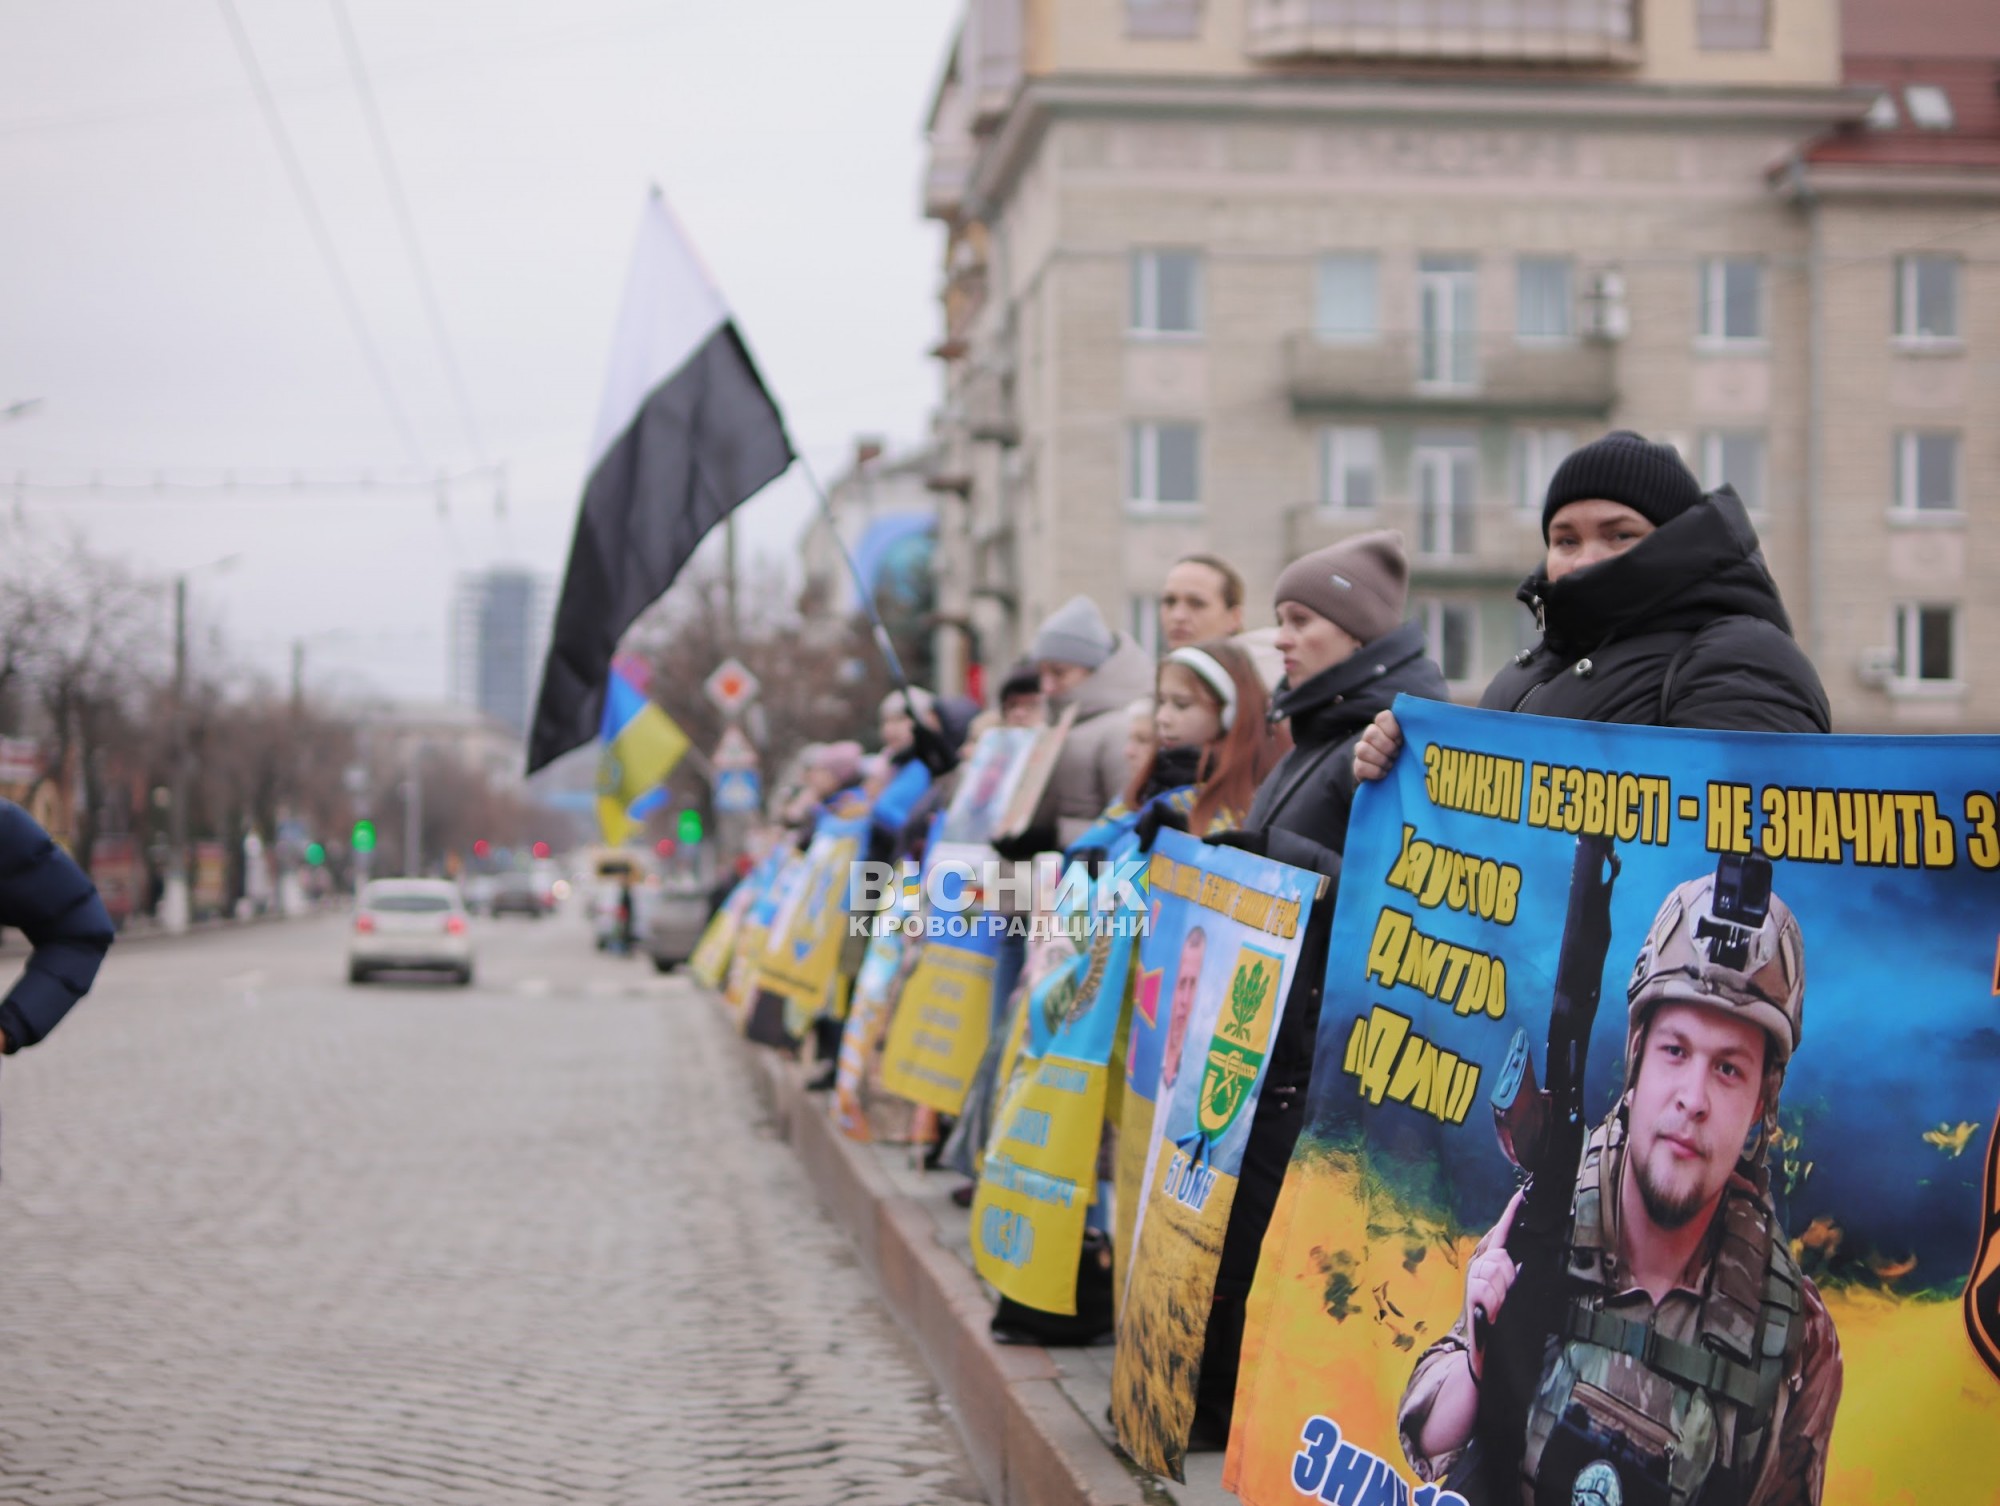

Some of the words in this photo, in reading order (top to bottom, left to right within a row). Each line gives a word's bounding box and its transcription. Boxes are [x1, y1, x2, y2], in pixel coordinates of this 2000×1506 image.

[1425, 743, 1524, 823] ЗНИКЛІ
[1528, 762, 1670, 846] БЕЗВІСТІ
[1706, 780, 1752, 854] НЕ
[1761, 784, 1956, 869] ЗНАЧИТЬ
[1964, 790, 2000, 871] З
